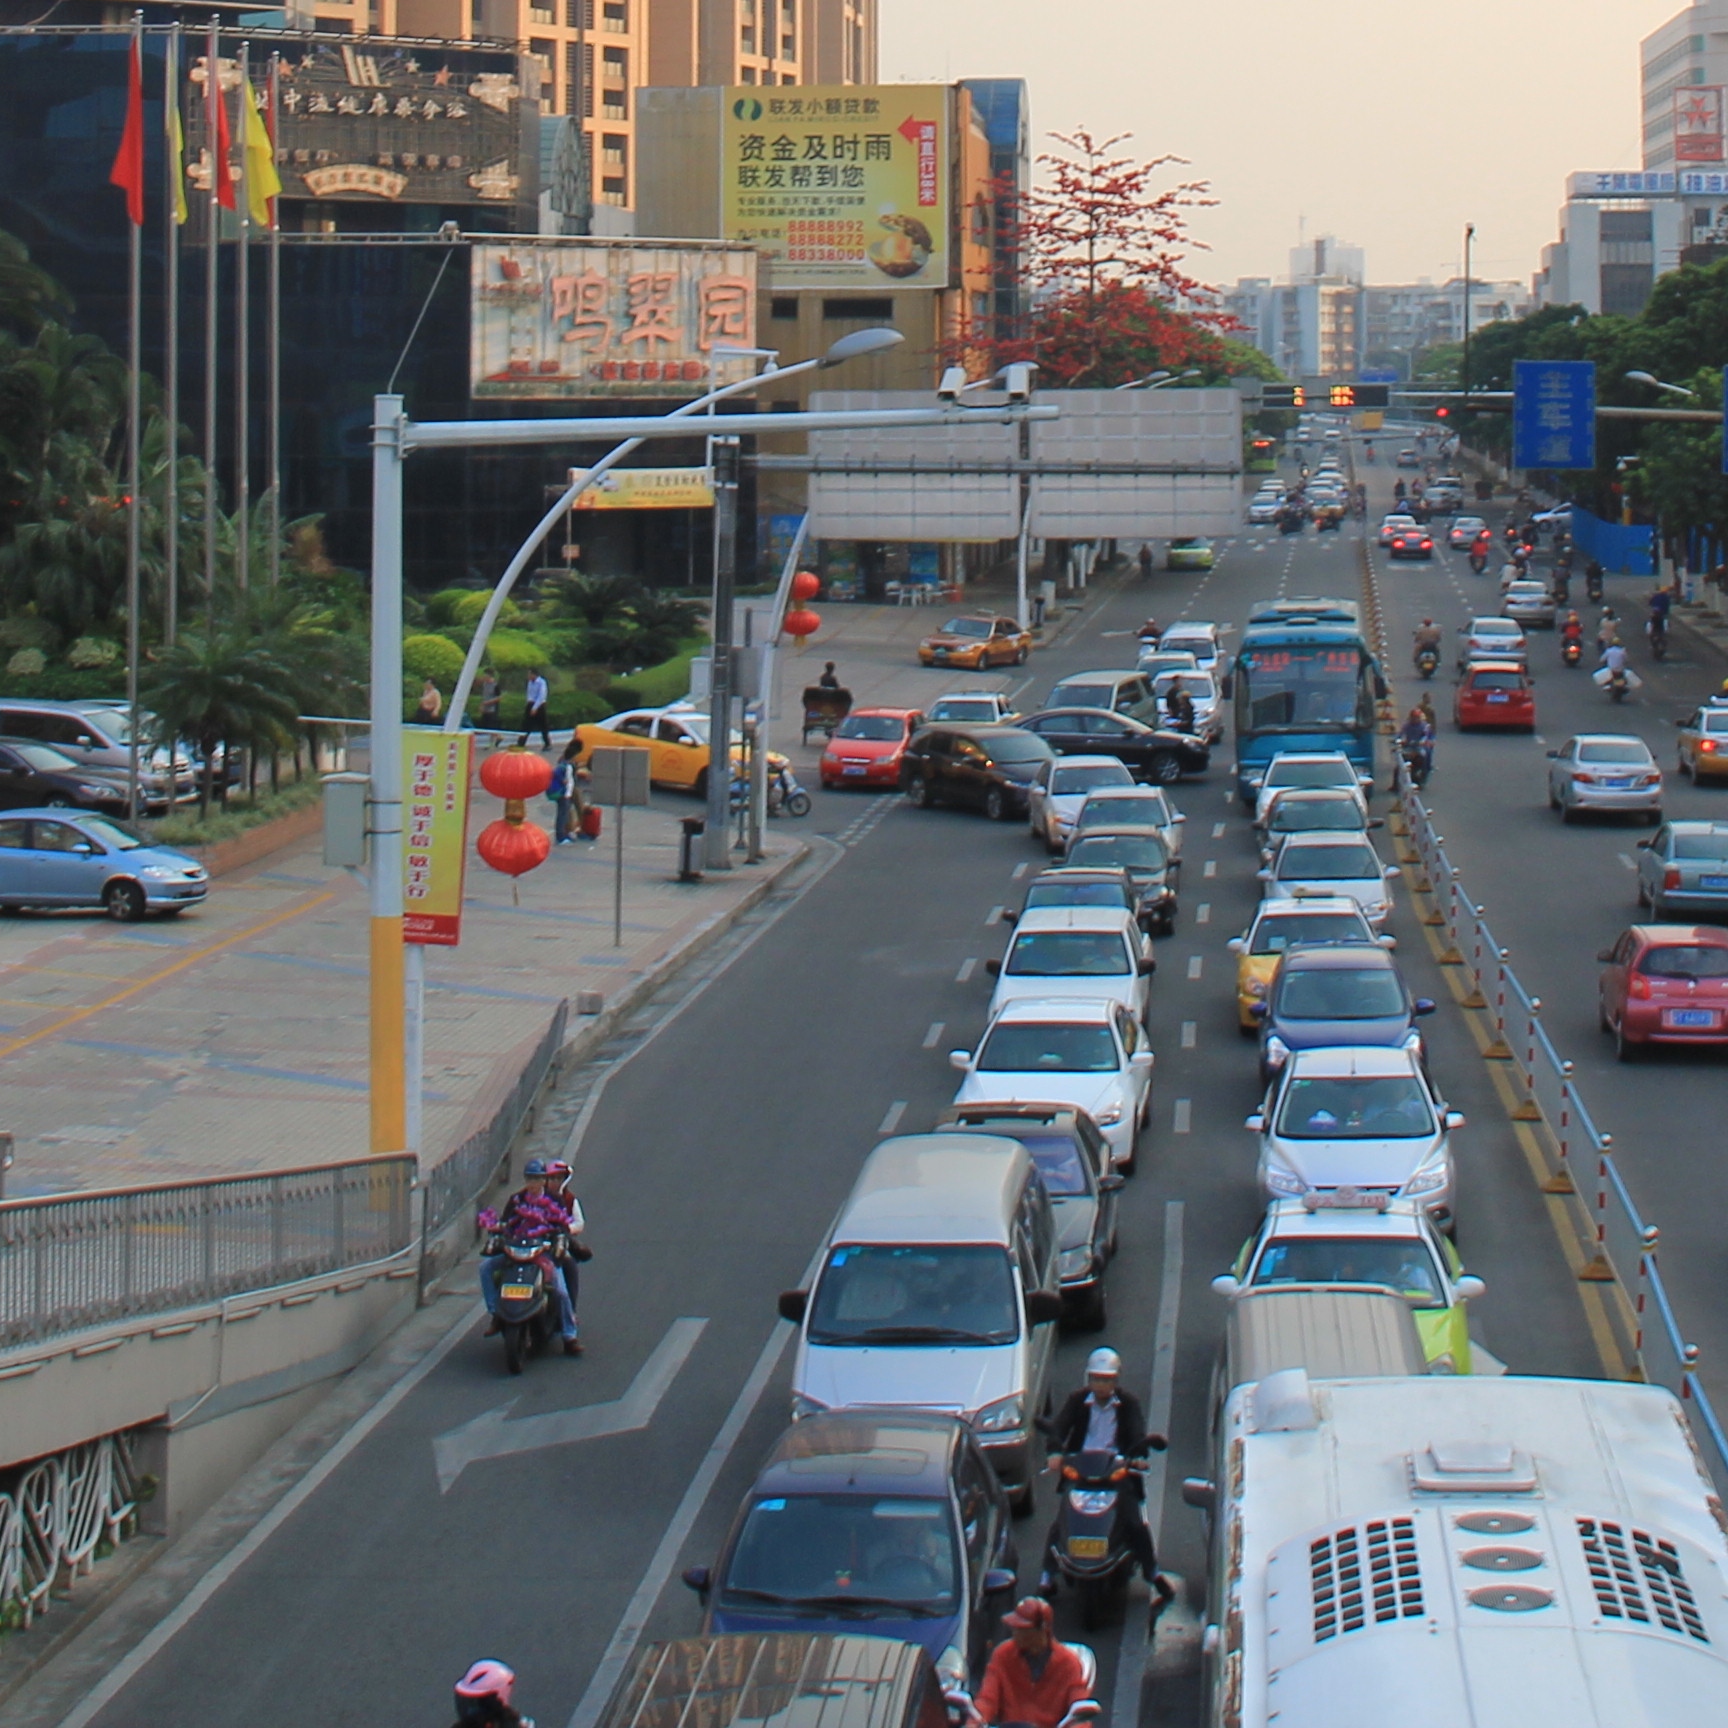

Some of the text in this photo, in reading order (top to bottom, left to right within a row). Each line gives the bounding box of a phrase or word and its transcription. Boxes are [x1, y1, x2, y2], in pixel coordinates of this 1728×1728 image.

[769, 98, 880, 116] 联发小额贷款
[739, 133, 892, 162] 资金及时雨
[738, 164, 865, 189] 联发帮到您
[788, 221, 864, 233] 88888992
[788, 234, 864, 246] 88888272
[788, 248, 865, 261] 88338000
[551, 266, 756, 354] 鸣翠园
